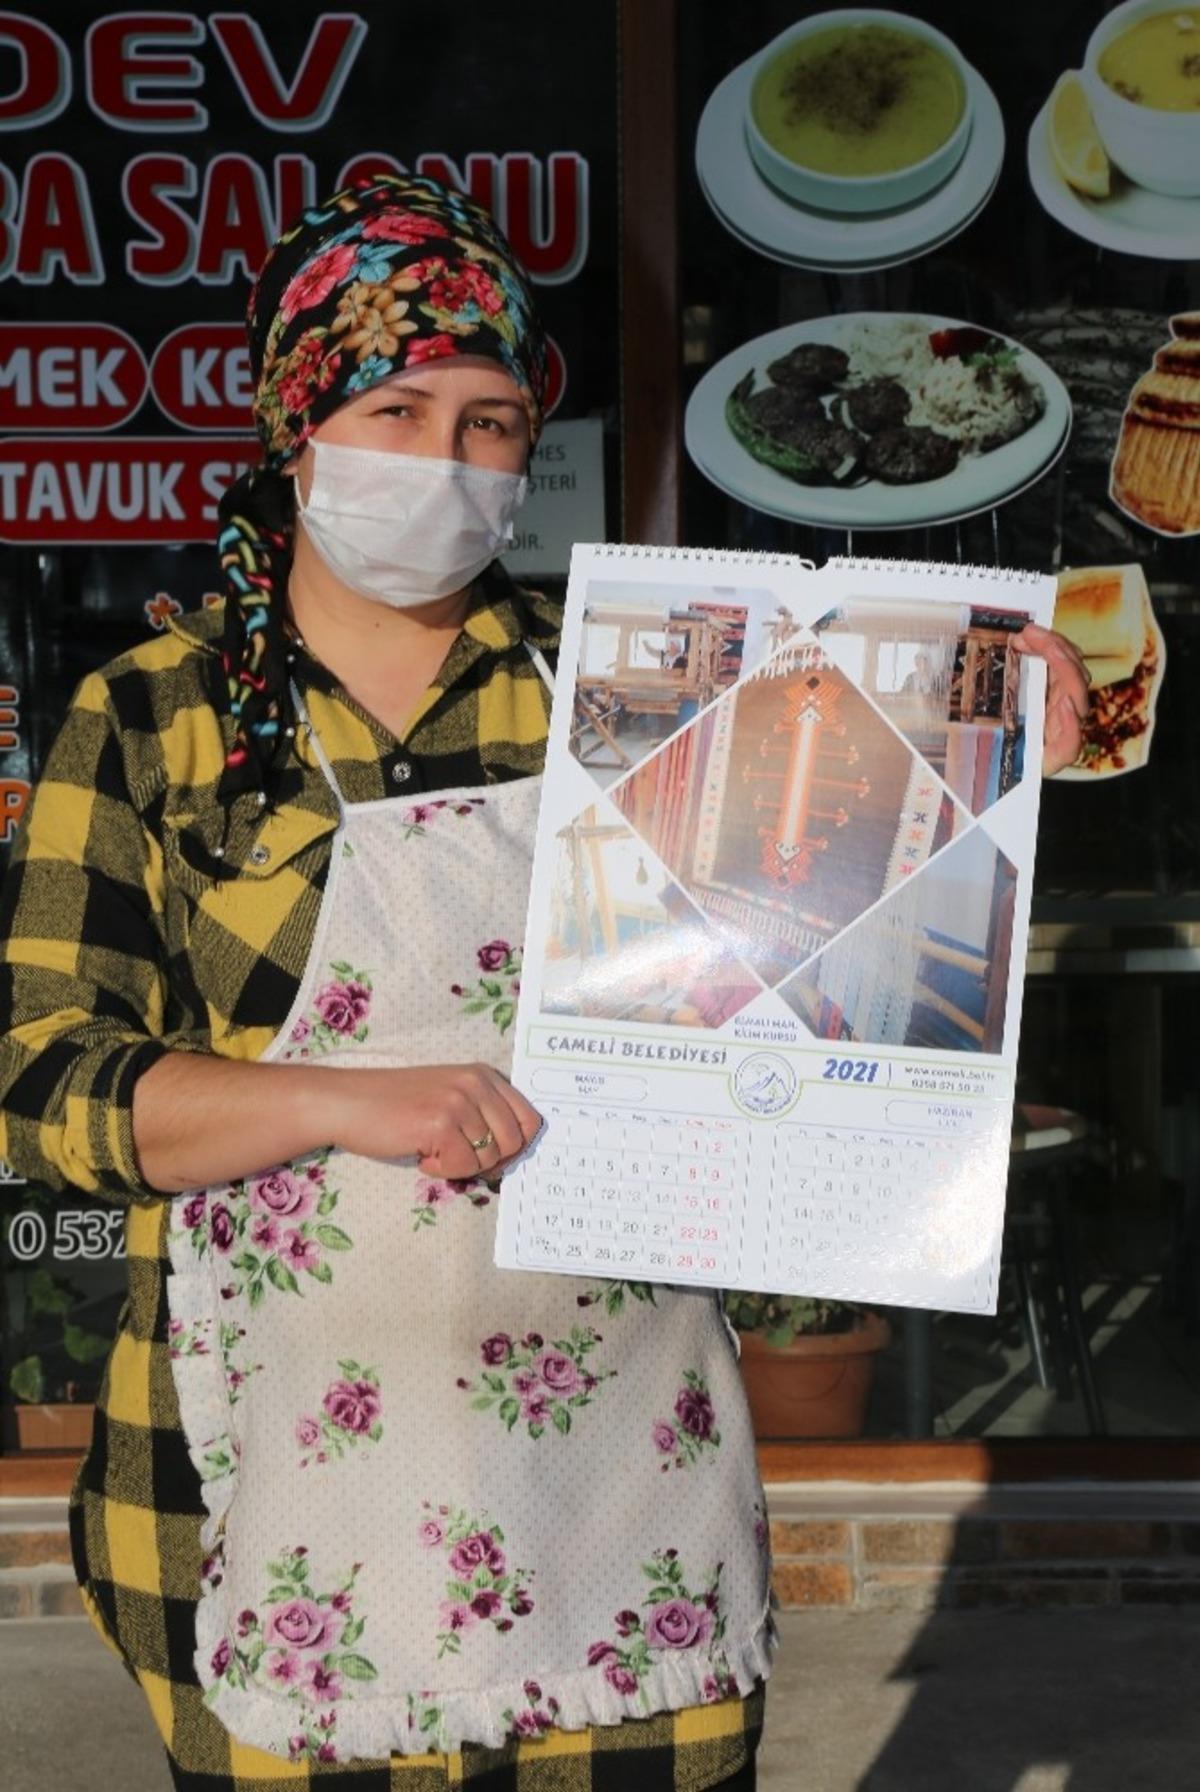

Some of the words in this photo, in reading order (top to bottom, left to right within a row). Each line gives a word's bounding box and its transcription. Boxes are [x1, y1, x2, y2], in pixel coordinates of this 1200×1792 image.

[0, 13, 367, 132] DEV
[0, 152, 105, 286] A
[122, 152, 590, 286] SAU
[0, 461, 186, 522] TAVUK
[201, 461, 251, 521] S
[527, 470, 578, 495] ŞTERİ
[509, 532, 545, 550] DİR.
[547, 1035, 616, 1055] ÇAMELİ
[621, 1041, 728, 1065] BELEDİYESİ
[823, 1058, 879, 1083] 2021
[8, 1210, 47, 1260] 0
[623, 1221, 639, 1234] 20
[680, 1227, 697, 1239] 22
[702, 1228, 718, 1241] 23
[566, 1245, 582, 1257] 25
[620, 1250, 636, 1262] 27
